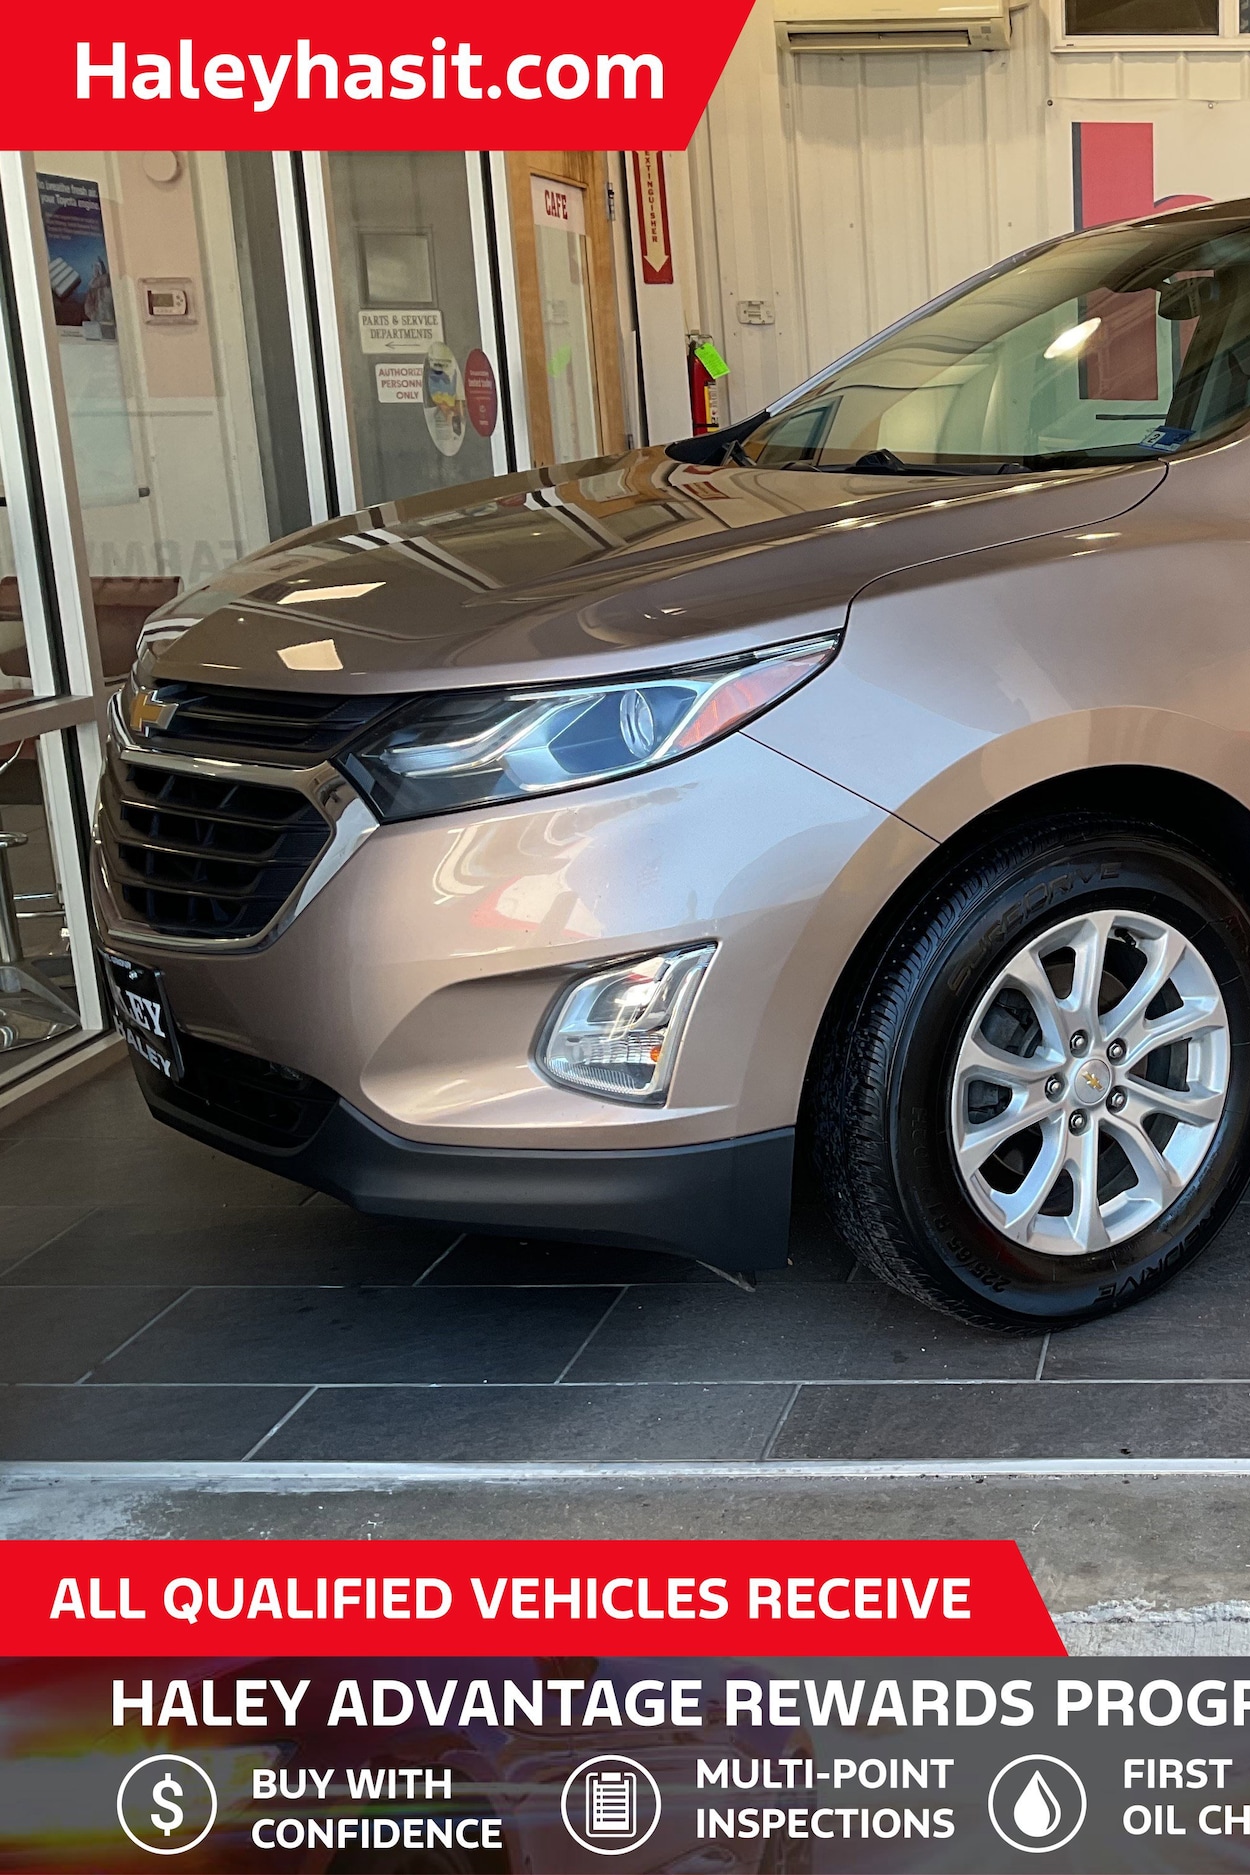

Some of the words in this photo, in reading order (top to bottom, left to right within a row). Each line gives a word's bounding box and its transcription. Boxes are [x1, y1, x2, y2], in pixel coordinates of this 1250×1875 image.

[645, 151, 658, 242] EXTINGUISHER
[544, 189, 568, 220] CAFE
[362, 315, 389, 326] PARTS
[392, 315, 399, 326] &
[401, 315, 439, 326] SERVICE
[370, 328, 433, 339] DEPARTMENTS
[378, 367, 424, 377] AUTHORIZ
[381, 379, 423, 389] PERSONN
[396, 391, 419, 399] ONLY
